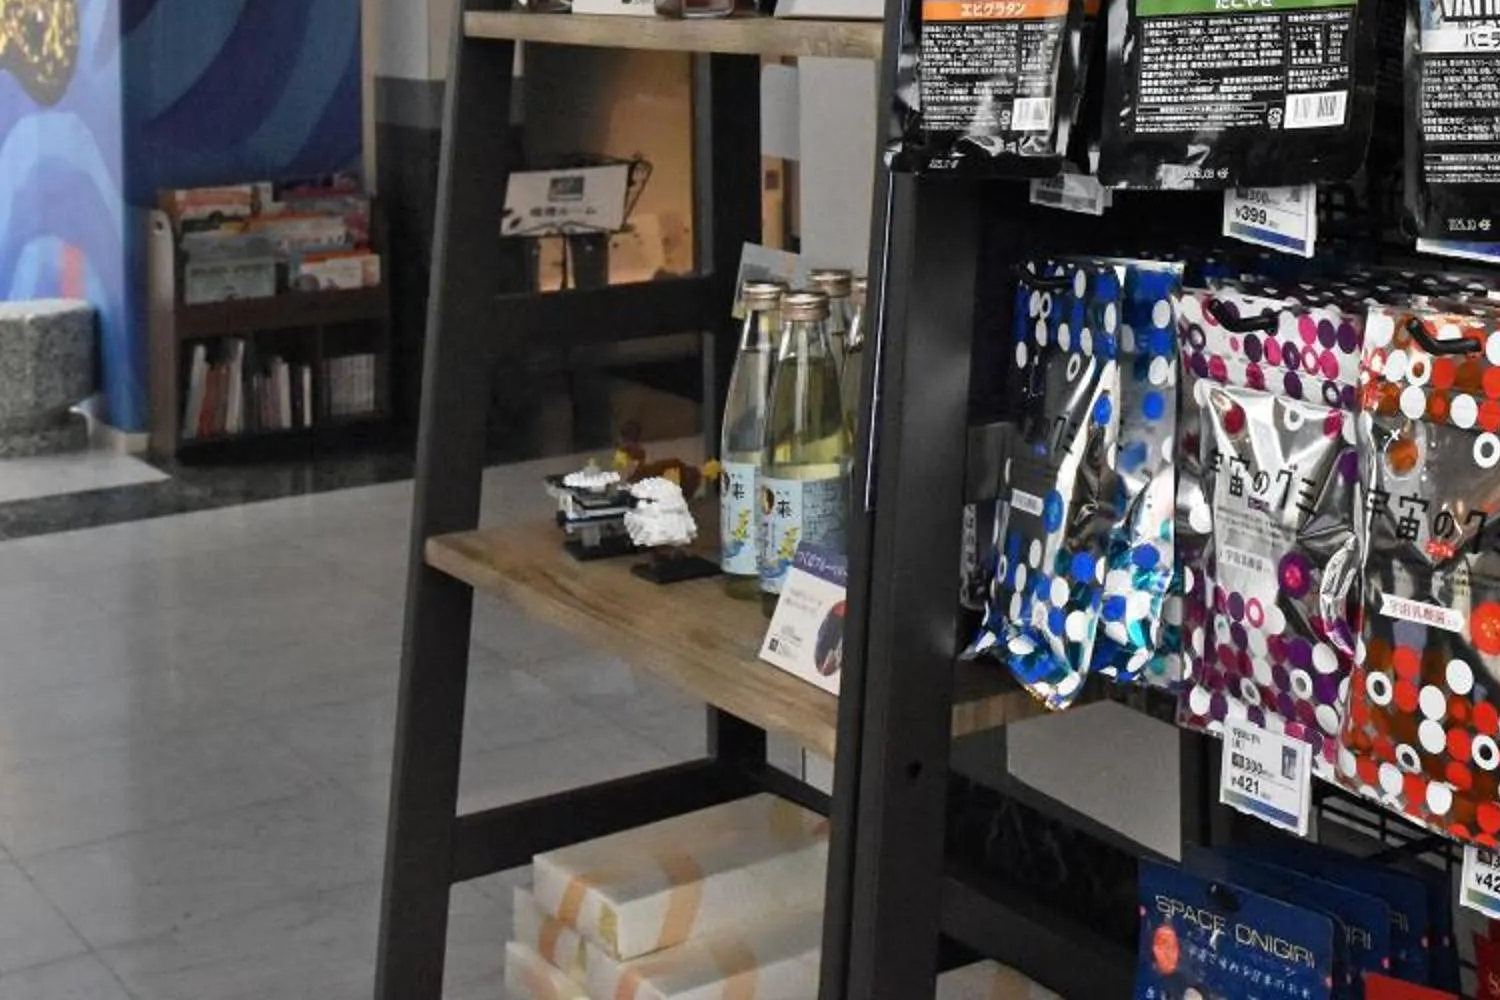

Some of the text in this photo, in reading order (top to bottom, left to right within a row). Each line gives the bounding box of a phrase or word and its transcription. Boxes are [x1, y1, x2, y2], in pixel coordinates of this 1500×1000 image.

[961, 3, 1026, 17] エビグラタン
[1235, 205, 1267, 225] ¥399
[1155, 895, 1226, 934] SPACE
